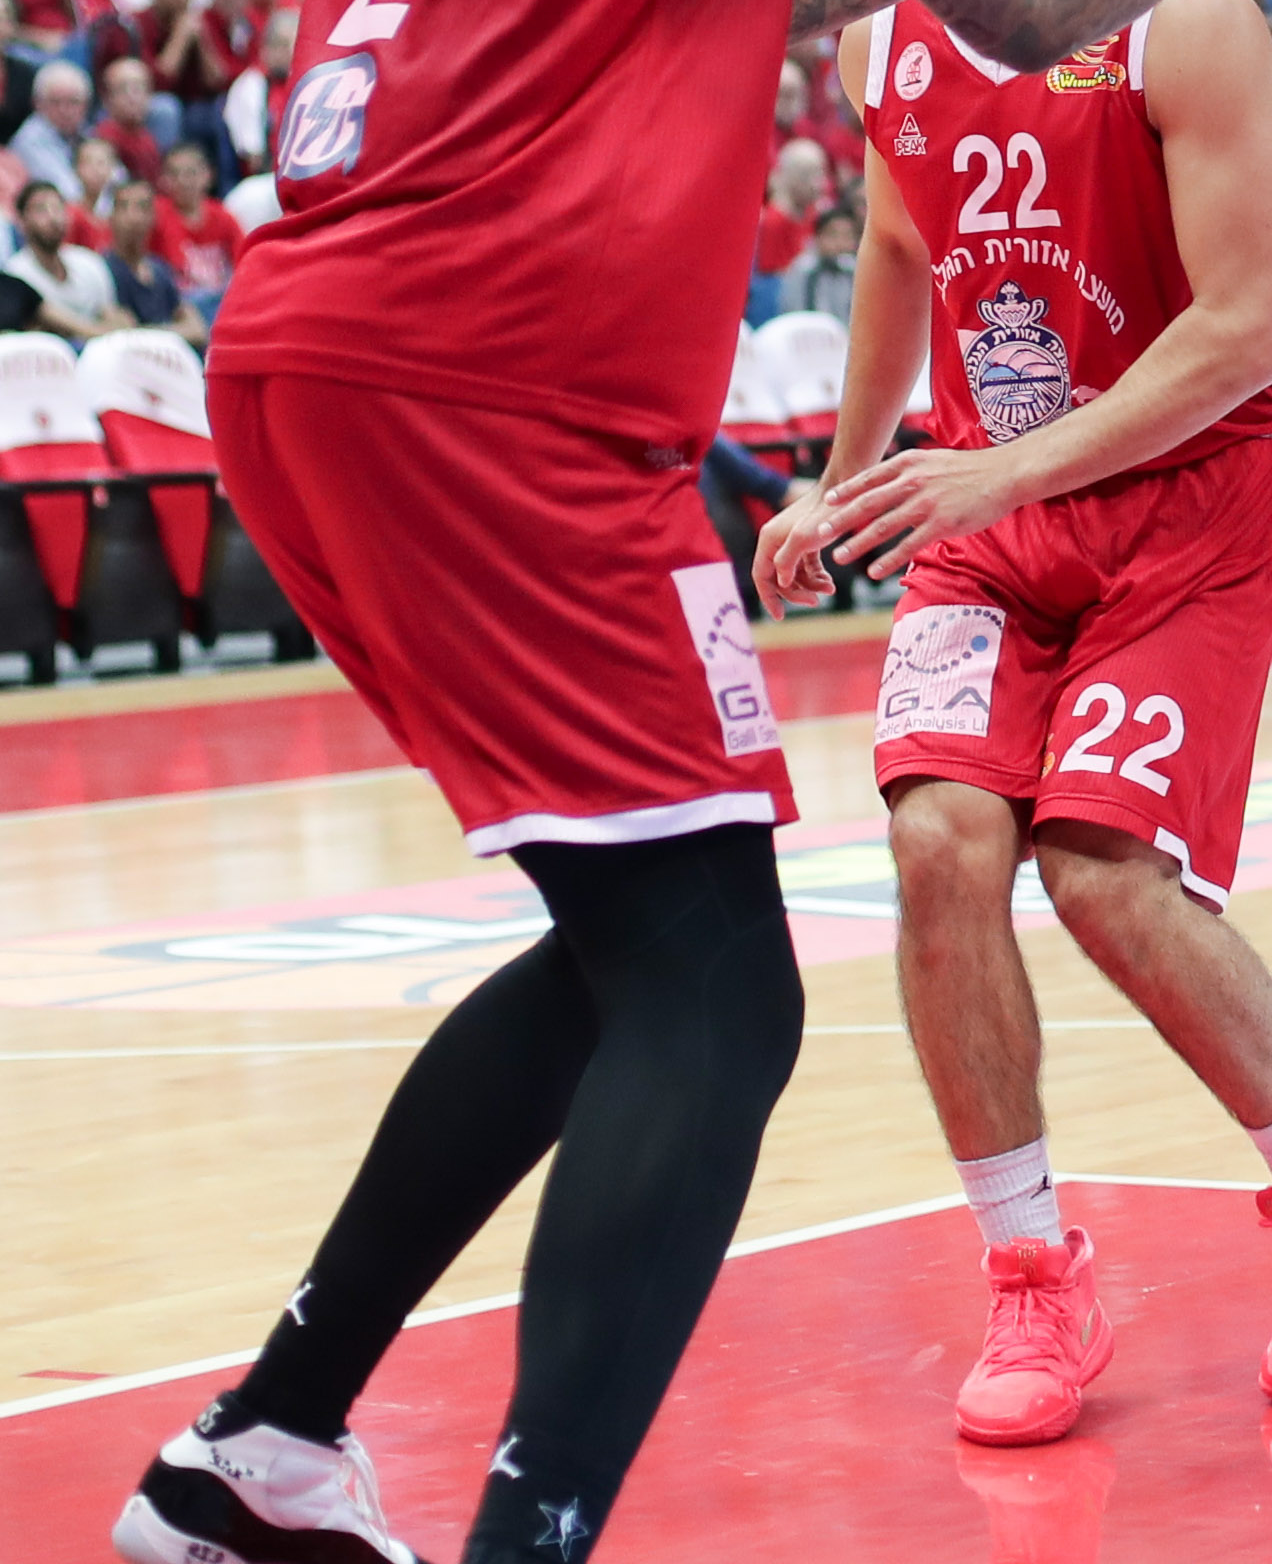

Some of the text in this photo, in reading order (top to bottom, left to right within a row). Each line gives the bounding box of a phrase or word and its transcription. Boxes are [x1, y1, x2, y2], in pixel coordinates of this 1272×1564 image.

[894, 136, 927, 156] PEAK
[953, 132, 1062, 235] 22
[983, 237, 1071, 273] אזורית
[1074, 260, 1126, 336] מועצה
[991, 327, 1042, 346] אזורית
[904, 715, 966, 736] Analysis
[1058, 682, 1185, 798] 22
